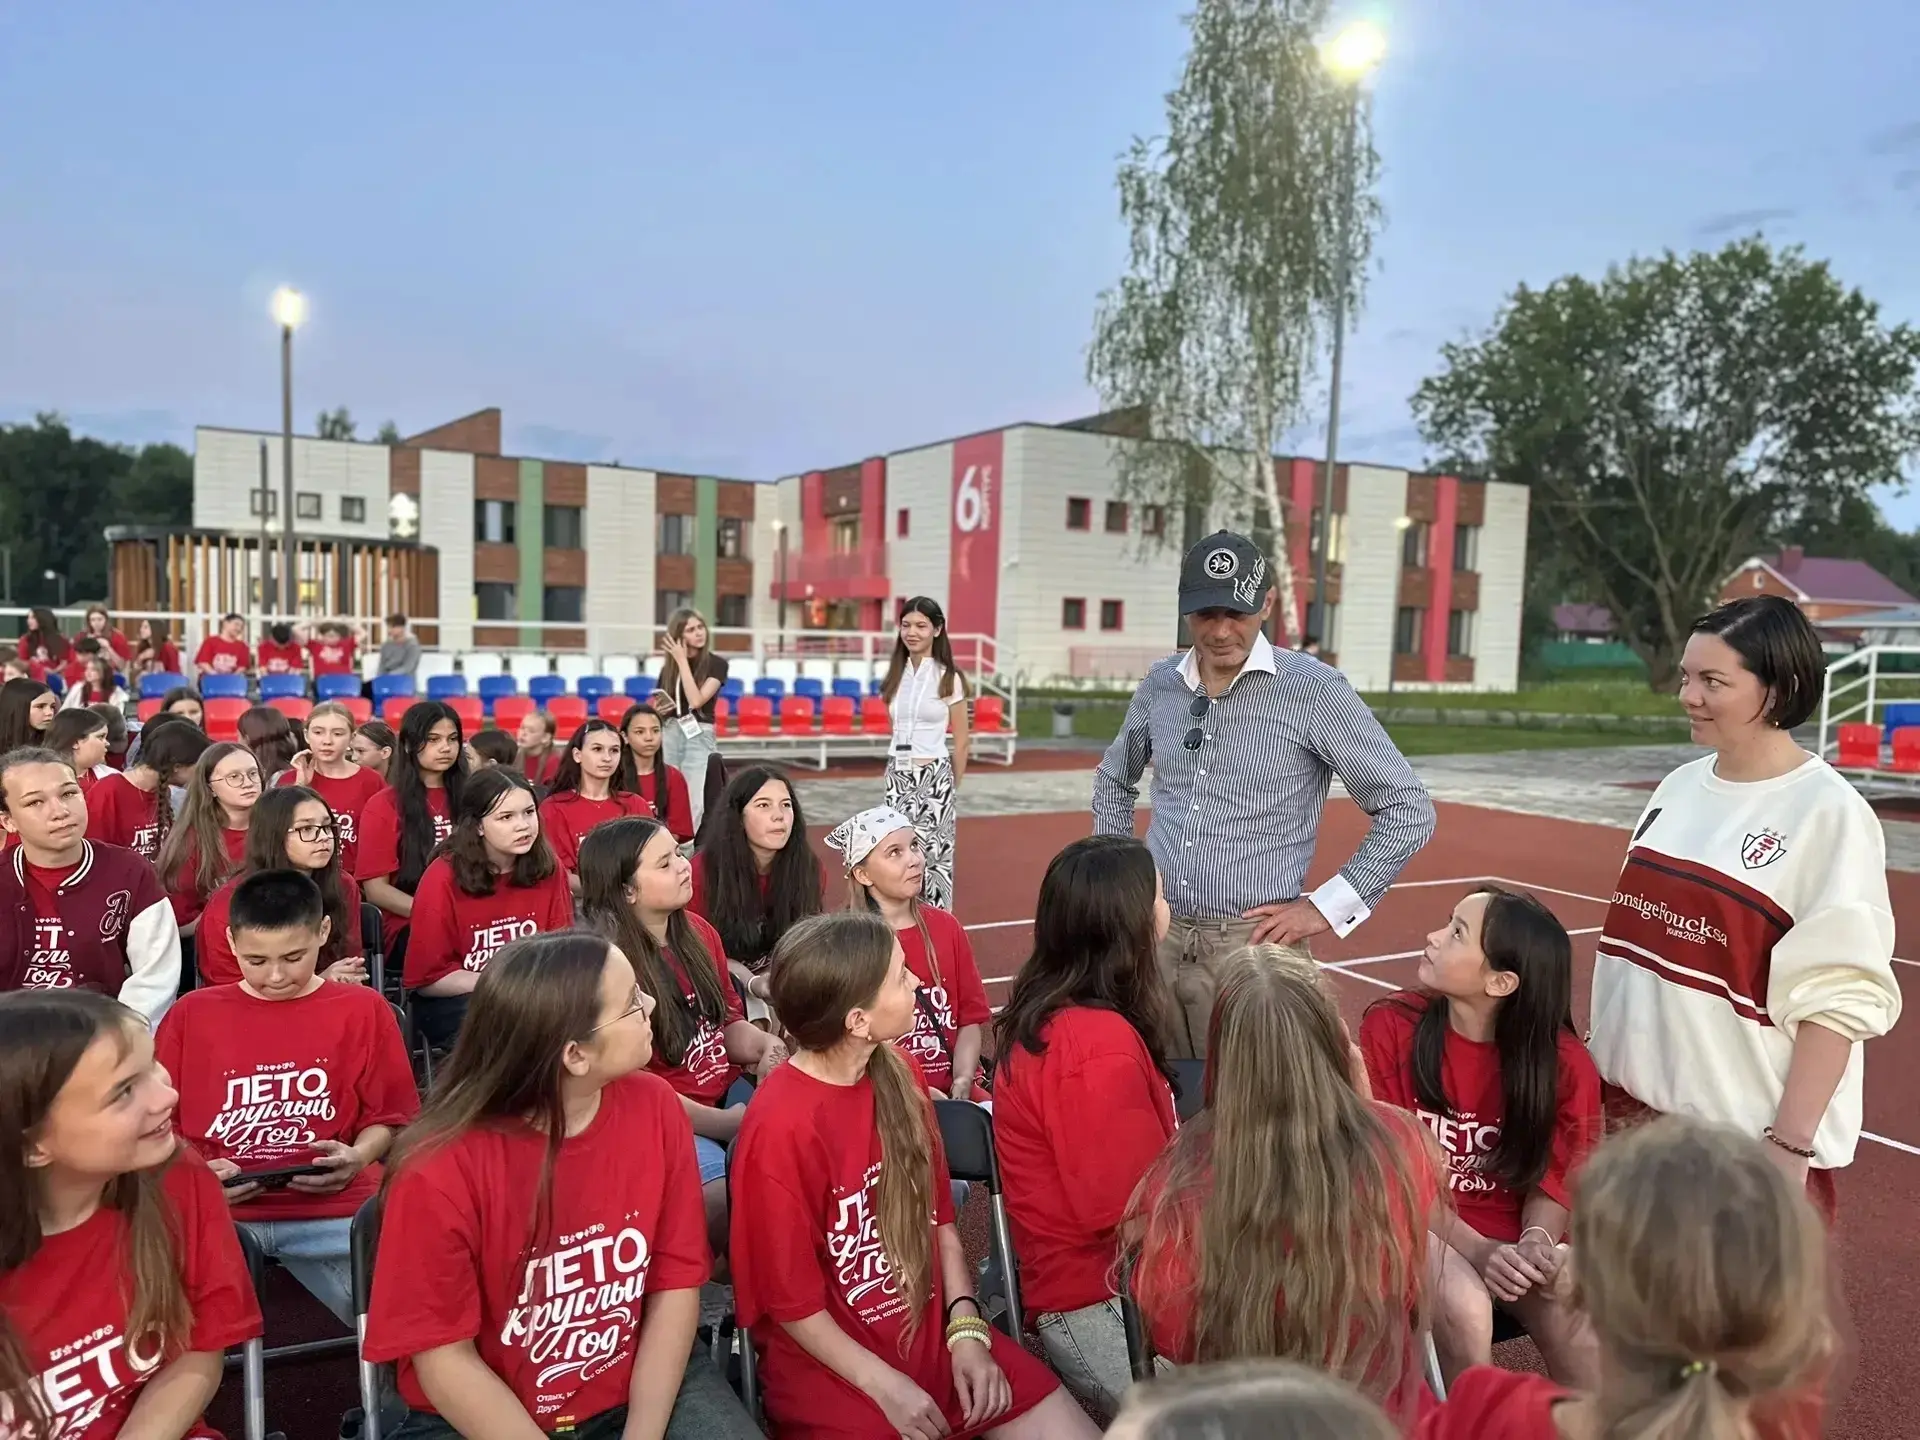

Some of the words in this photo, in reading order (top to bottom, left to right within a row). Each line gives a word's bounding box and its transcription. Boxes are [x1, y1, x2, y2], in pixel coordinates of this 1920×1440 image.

[956, 464, 981, 532] 6
[471, 919, 537, 952] ЛЕТО
[222, 1067, 328, 1111] ЛЕТО
[204, 1091, 336, 1147] круглый
[518, 1227, 648, 1304] ЛЕТО
